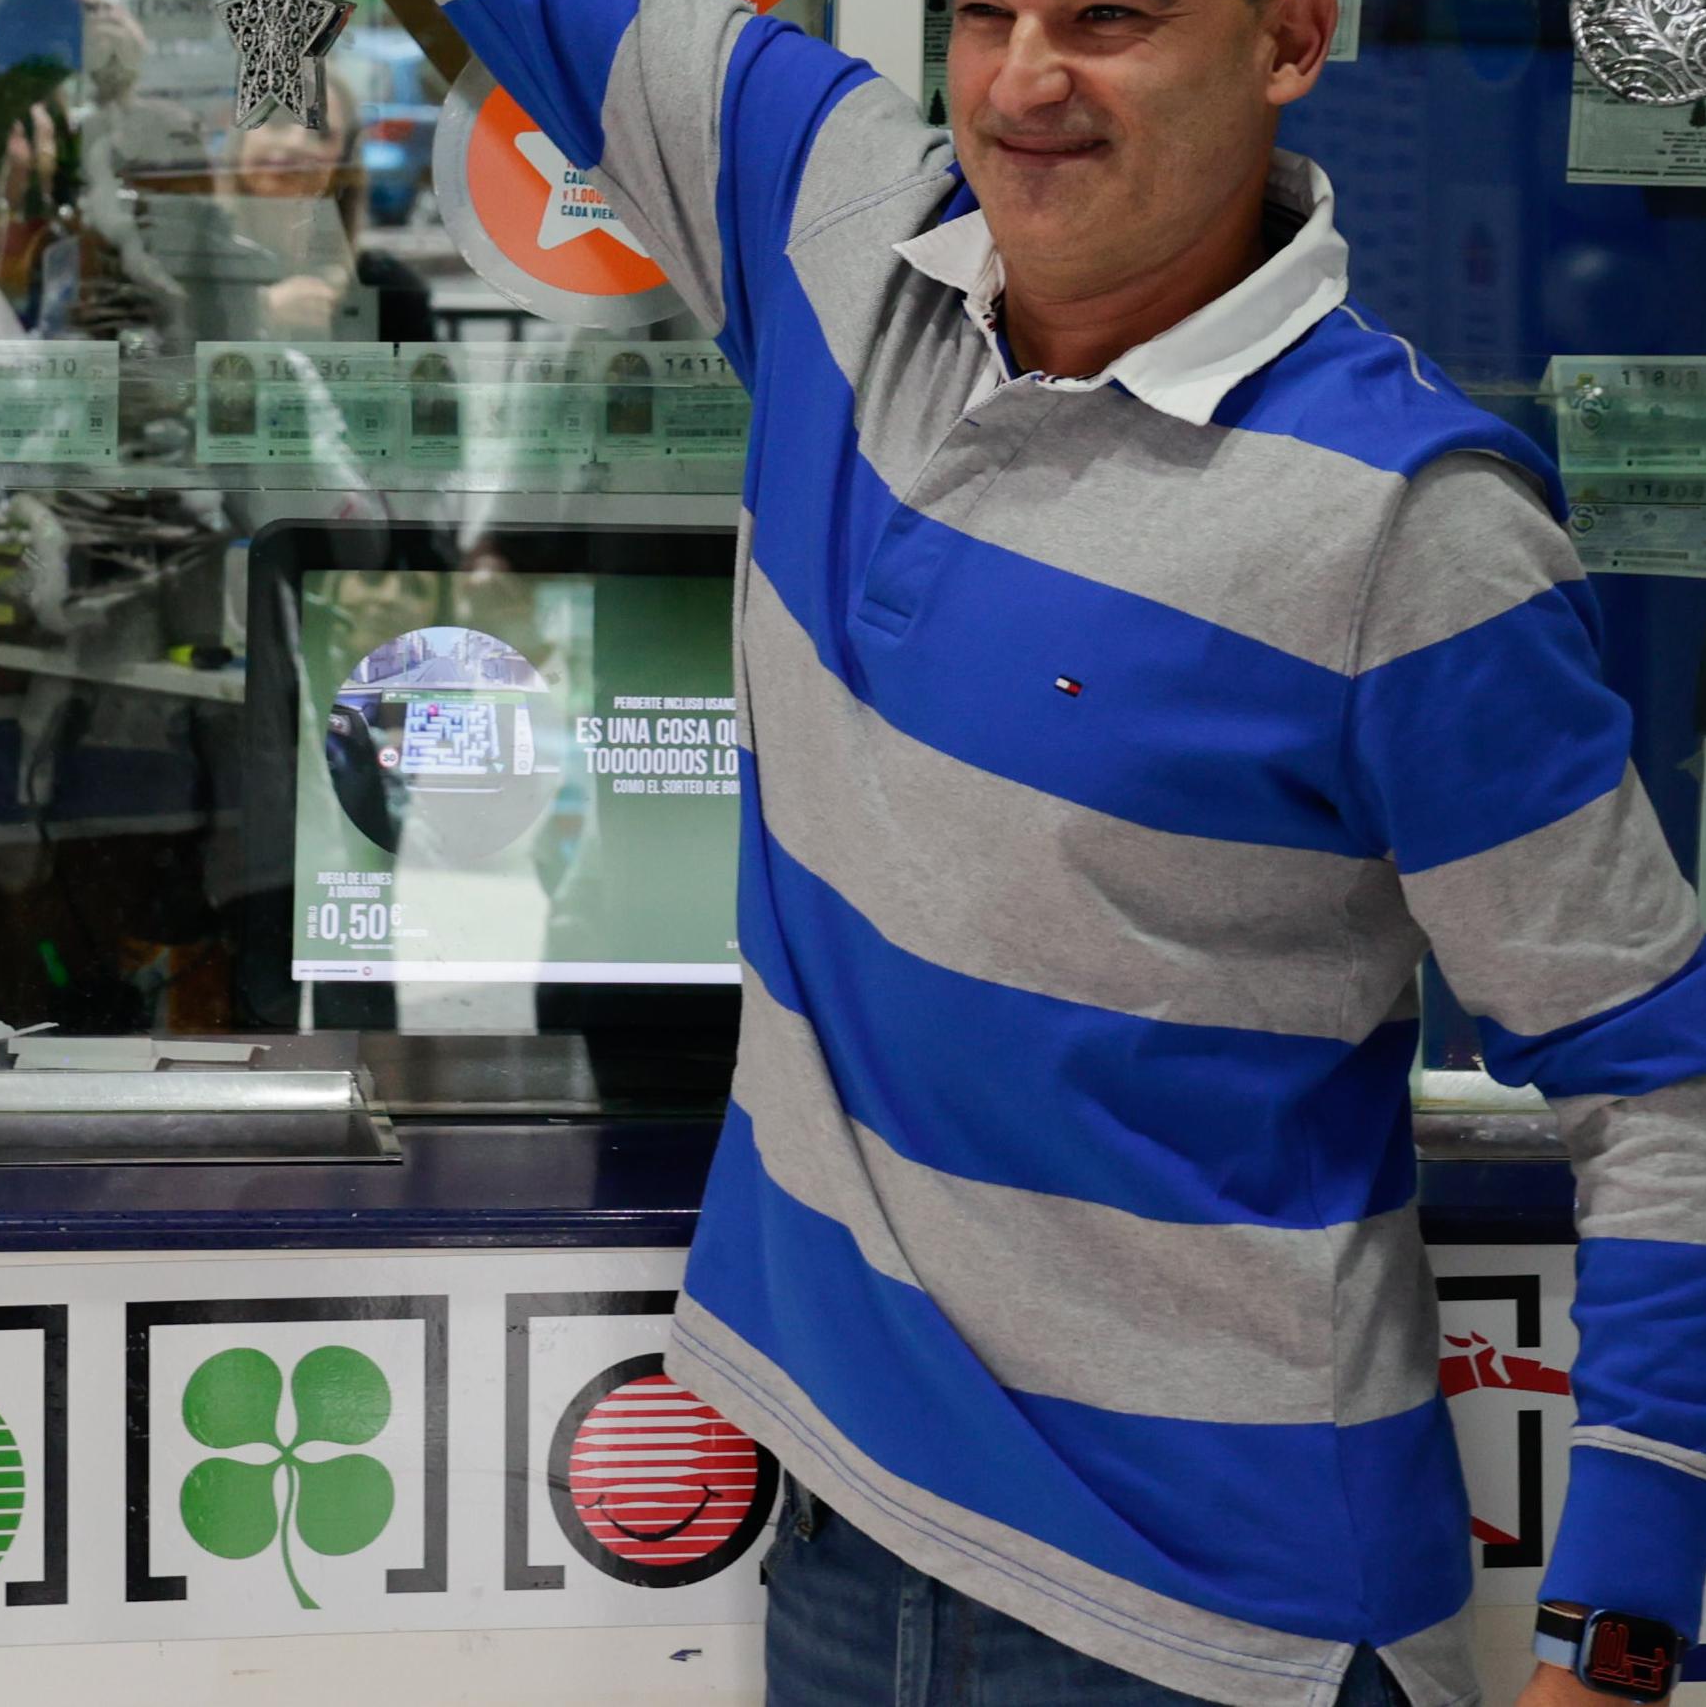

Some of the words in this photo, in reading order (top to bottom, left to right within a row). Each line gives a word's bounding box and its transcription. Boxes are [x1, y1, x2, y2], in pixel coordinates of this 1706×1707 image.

[561, 205, 589, 219] CADA
[664, 697, 704, 710] INCLUSO
[576, 717, 603, 743] ES
[607, 717, 651, 744] UNA
[656, 718, 711, 744] COSA
[613, 779, 645, 794] COMO
[647, 779, 661, 794] EL
[662, 780, 704, 794] SORTEO
[705, 780, 721, 794] DE
[319, 902, 388, 946] 0,50
